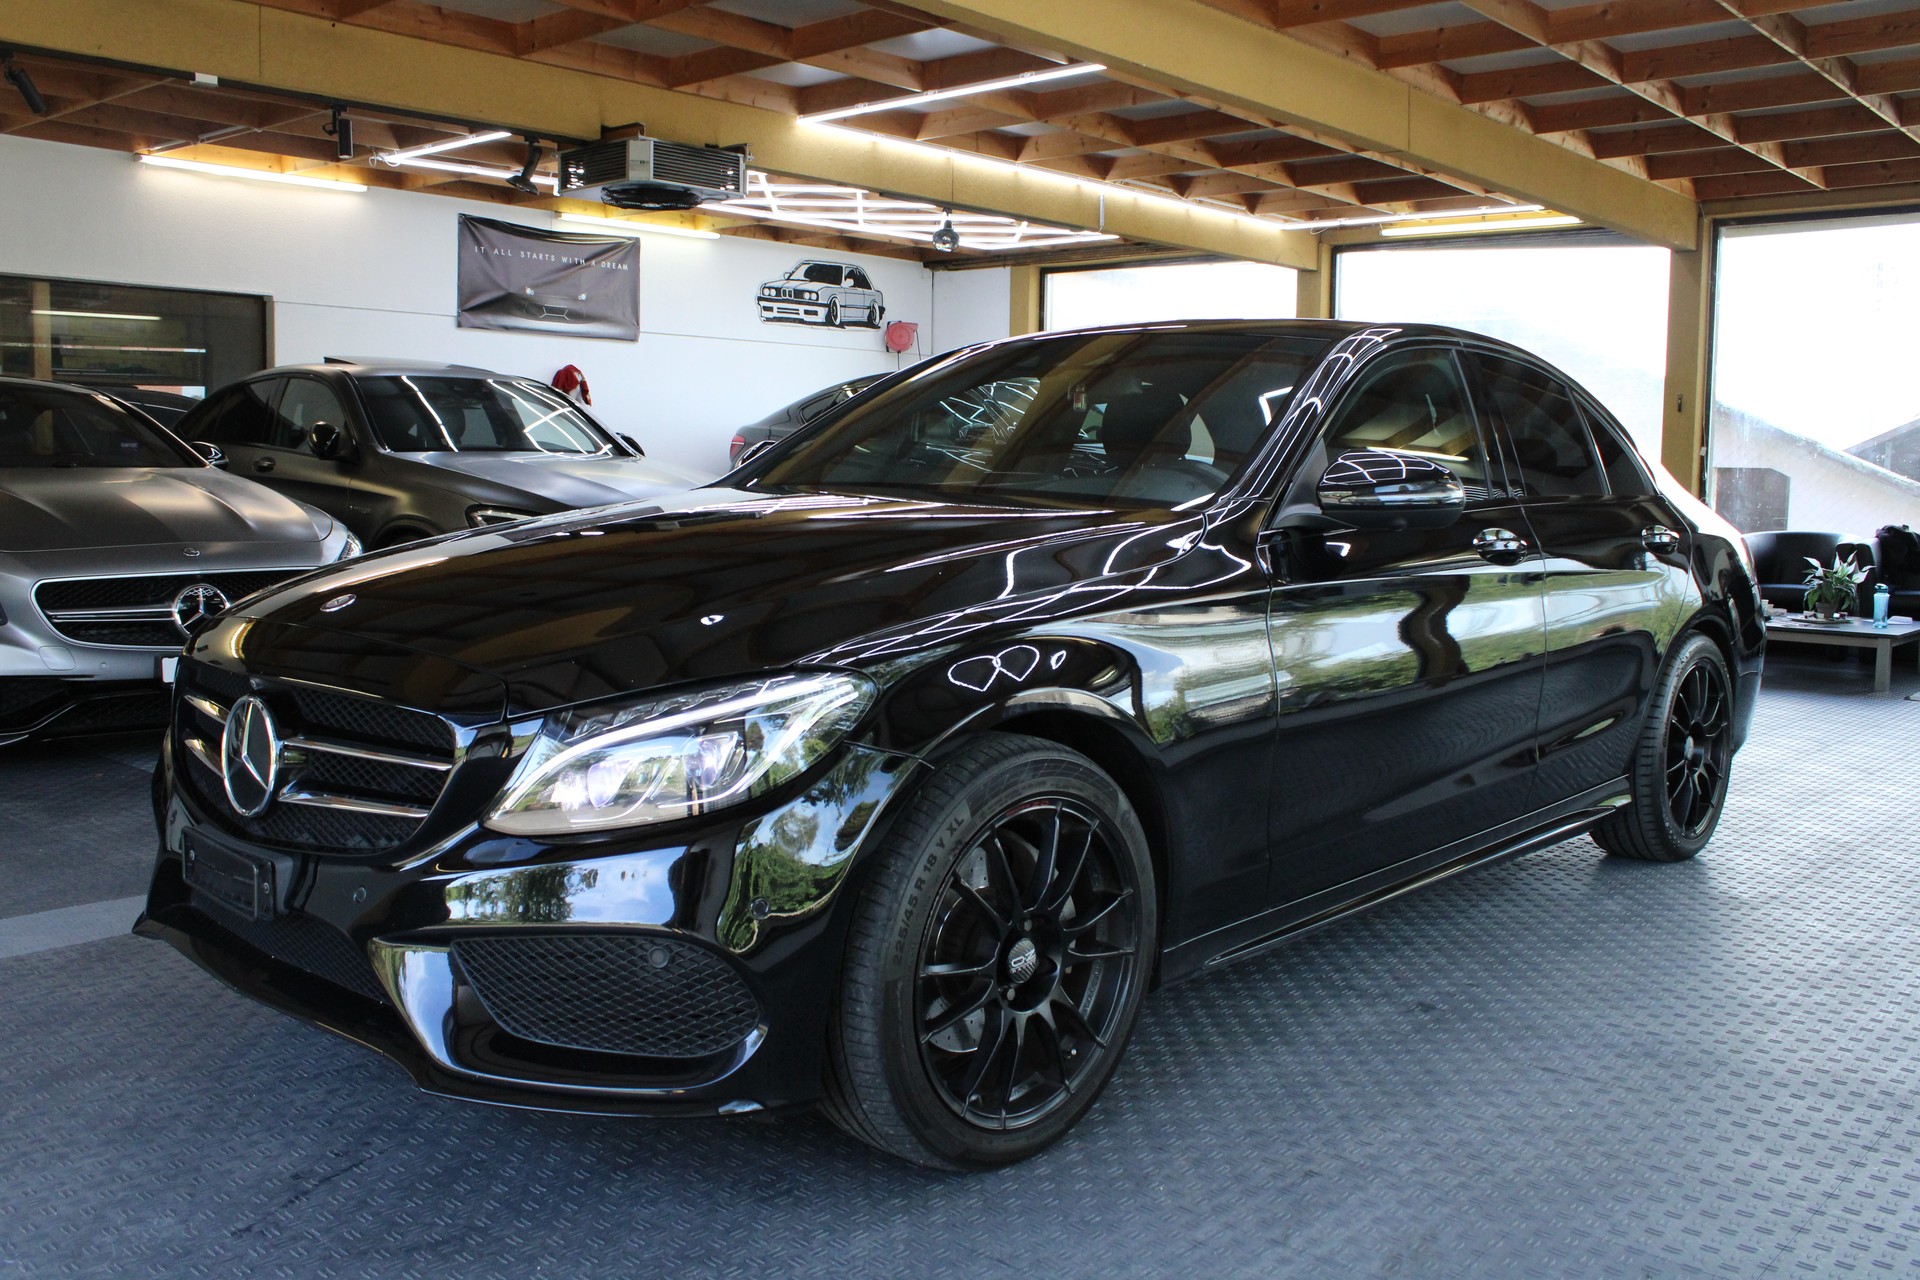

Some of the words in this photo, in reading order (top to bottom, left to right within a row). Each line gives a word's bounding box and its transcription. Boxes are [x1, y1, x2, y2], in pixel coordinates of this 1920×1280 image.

[474, 246, 485, 254] IT
[493, 246, 513, 257] ALL
[520, 251, 556, 262] STARTS
[561, 256, 586, 266] WITH
[601, 261, 629, 271] DREAM
[914, 877, 926, 892] R
[923, 853, 938, 874] 18
[936, 837, 946, 850] Y
[945, 816, 965, 838] XL
